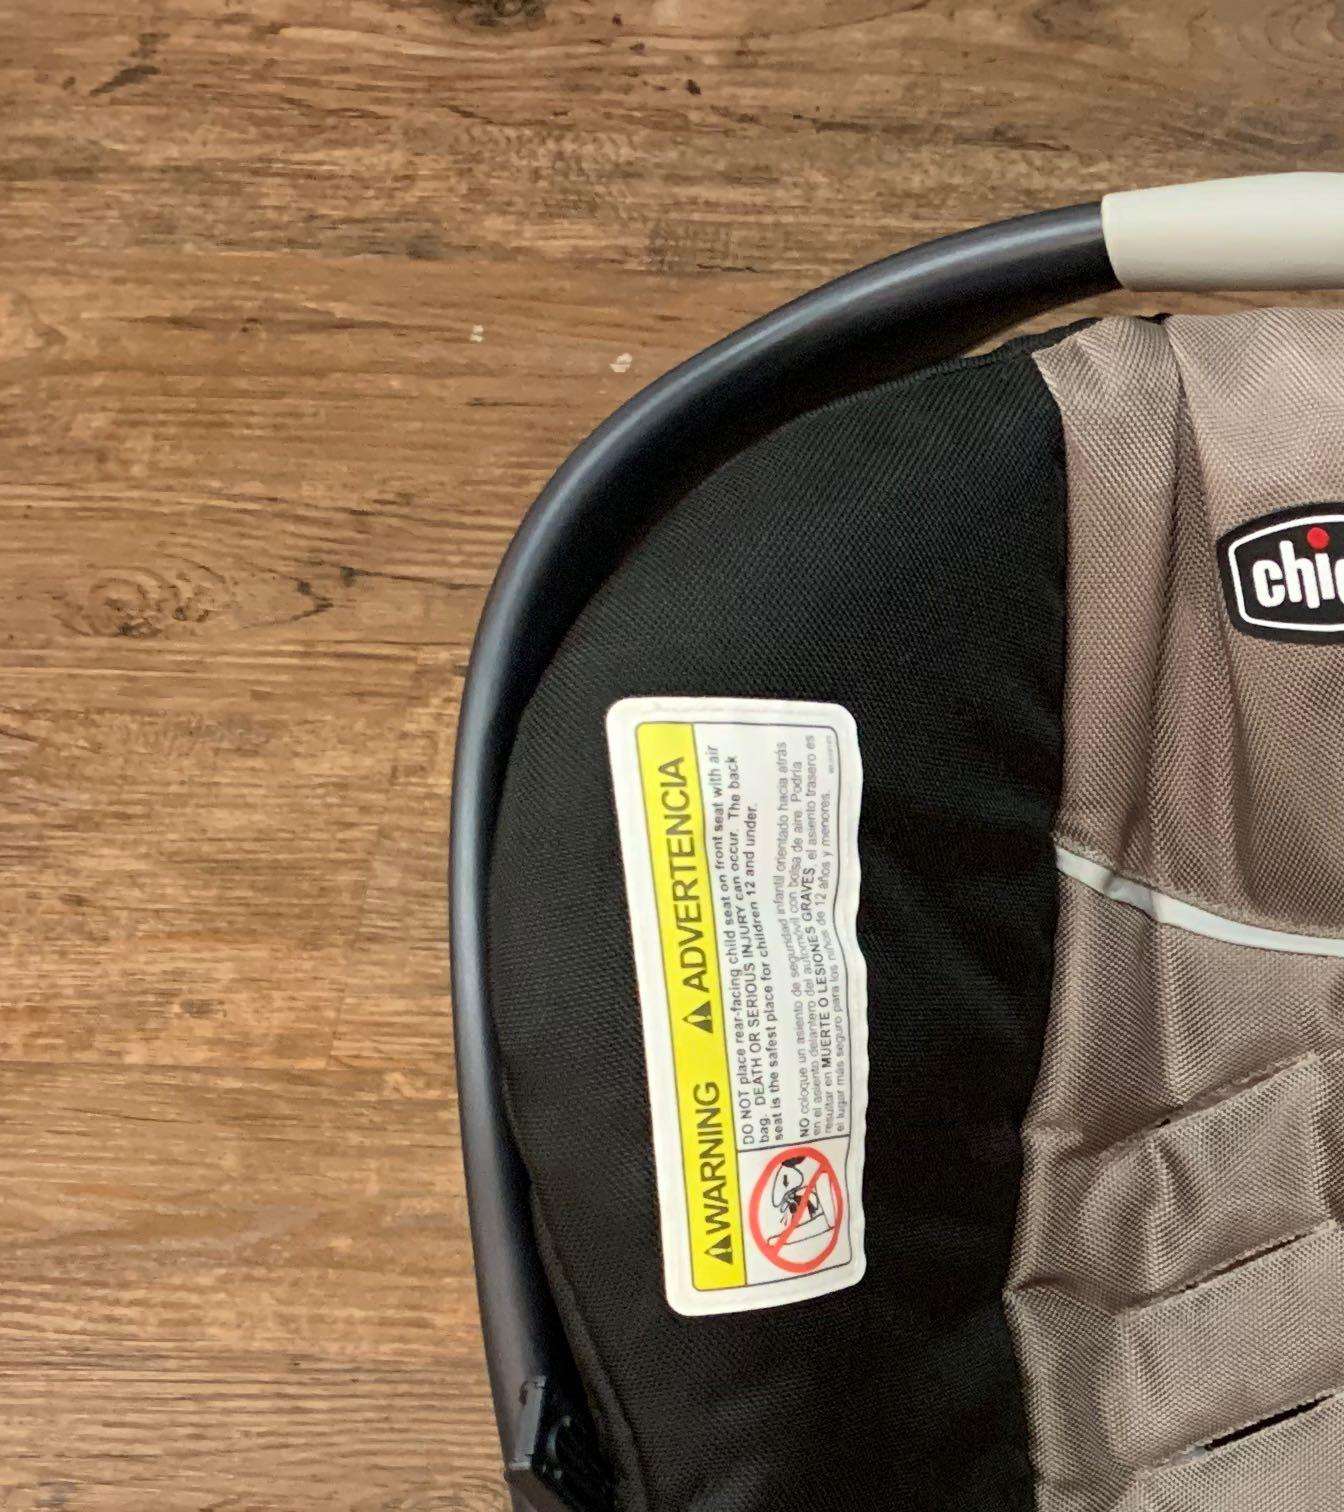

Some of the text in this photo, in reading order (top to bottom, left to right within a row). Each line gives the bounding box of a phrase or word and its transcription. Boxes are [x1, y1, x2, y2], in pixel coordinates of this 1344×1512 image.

[657, 756, 731, 1235] WARNING ADVERTENCIA
[705, 745, 754, 1145] DO NOT place rear-facing child seat on front seat with air
[724, 756, 770, 1143] bag. DEATH OR SERIOUS INJURY can occur. The back
[742, 803, 783, 1141] seat is the safest place for children 12 and under.
[804, 925, 827, 993] LESIONES
[818, 997, 829, 1007] O
[819, 1011, 832, 1067] MUERTE
